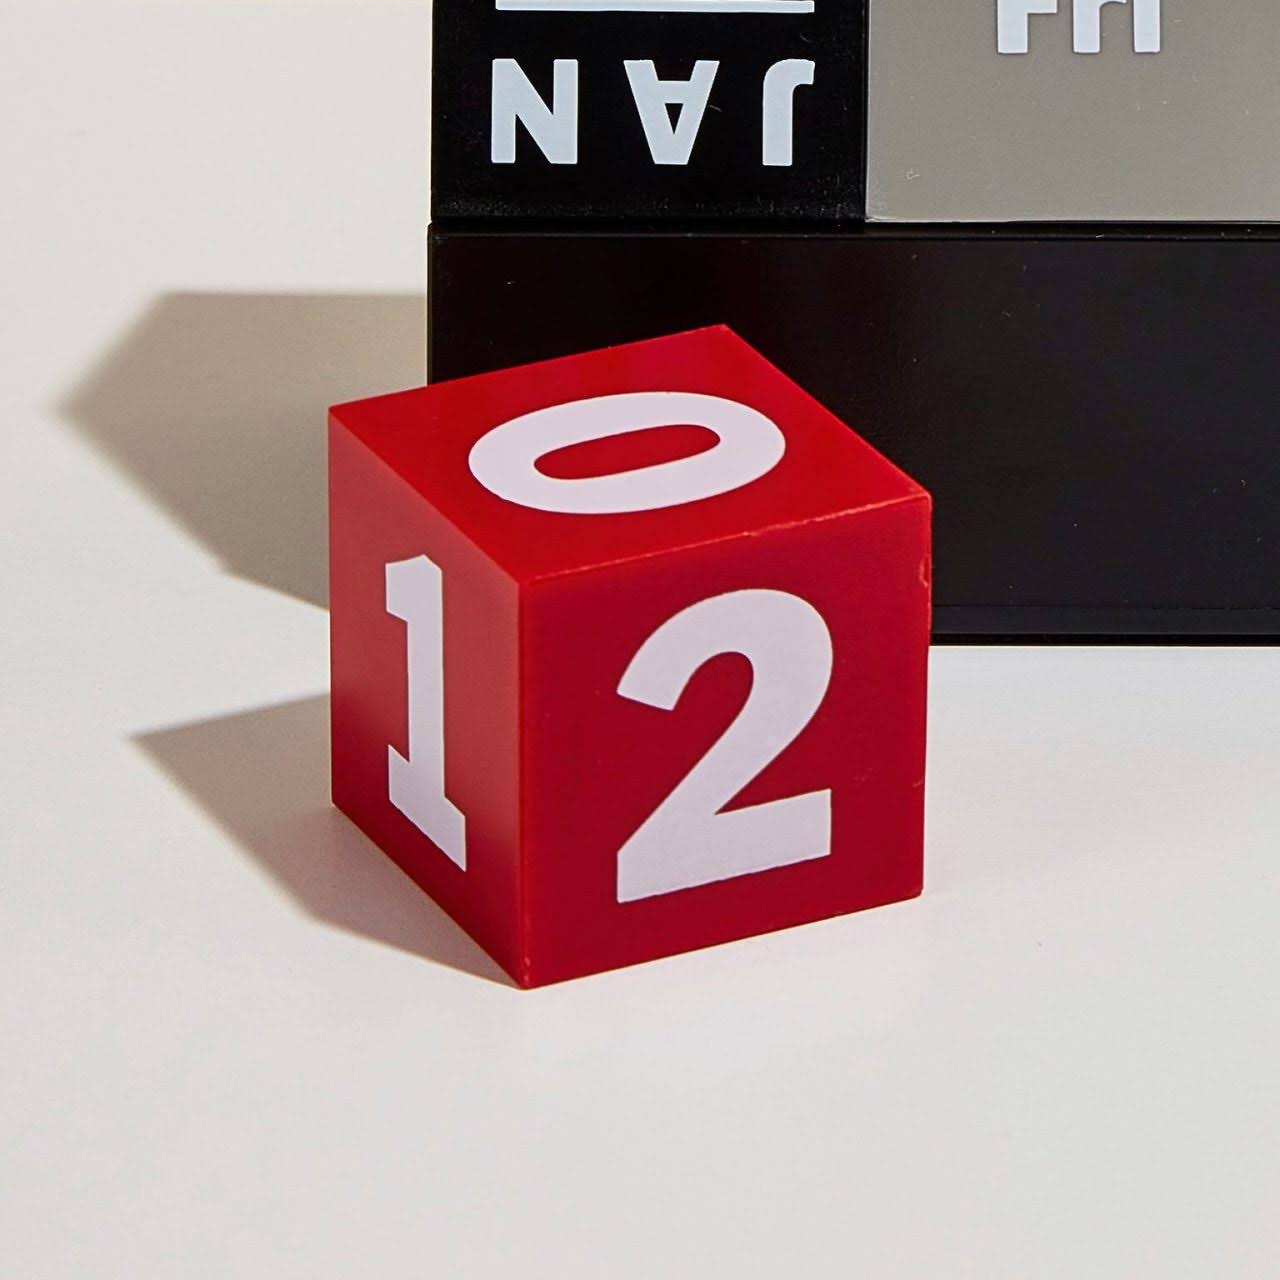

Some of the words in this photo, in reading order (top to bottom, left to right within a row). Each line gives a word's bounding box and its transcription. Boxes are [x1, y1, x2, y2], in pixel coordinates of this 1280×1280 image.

[491, 59, 815, 166] JAN
[469, 392, 785, 514] 0
[385, 555, 466, 871] 1
[617, 589, 833, 903] 2
